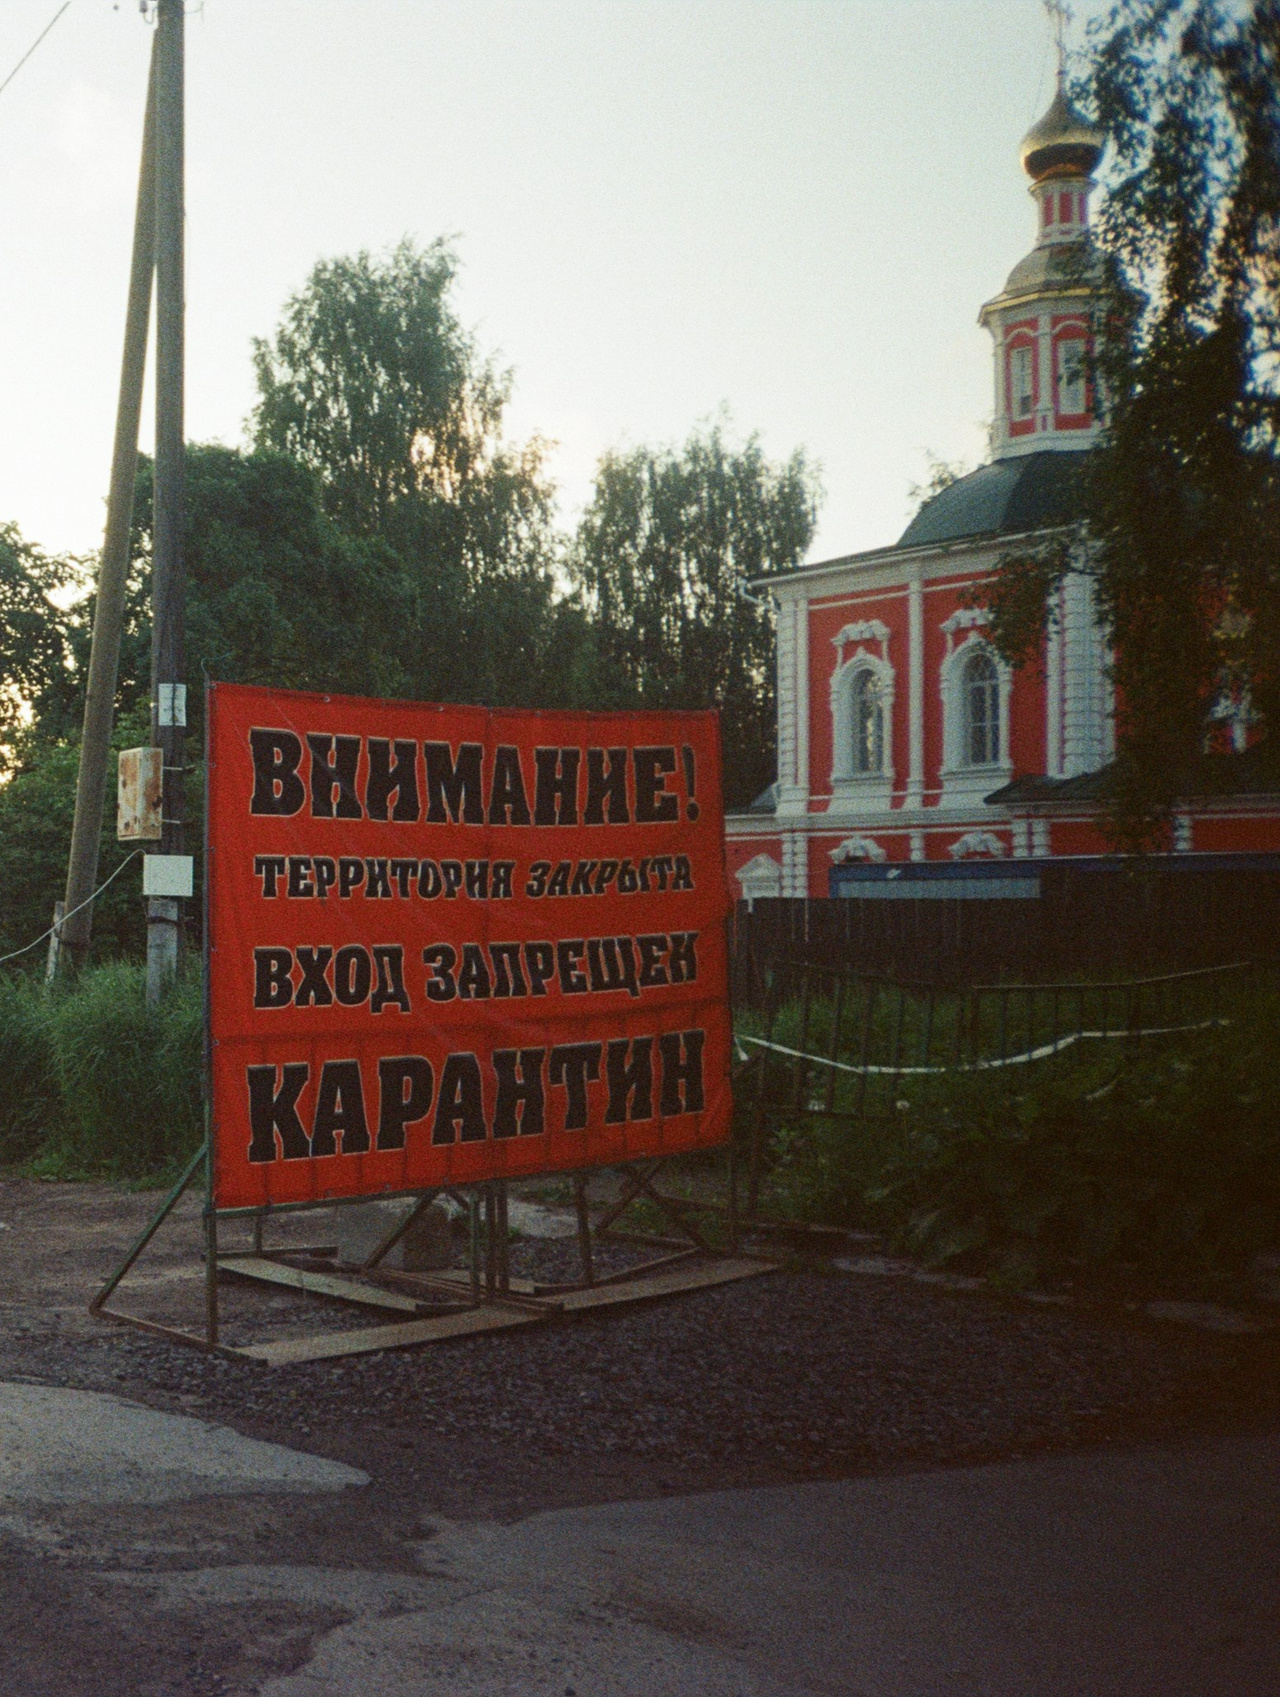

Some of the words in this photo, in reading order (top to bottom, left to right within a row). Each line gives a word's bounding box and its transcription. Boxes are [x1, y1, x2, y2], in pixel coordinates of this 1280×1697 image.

[249, 728, 700, 827] ВНИМАНИЕ!
[254, 854, 515, 899] ТЕРРИТОРИЯ
[526, 855, 695, 897] ЗАКРЫТА
[253, 943, 411, 1014] ВХОД
[423, 931, 699, 1003] ЗАПРЕЩЕН
[247, 1029, 706, 1163] КАРАНТИН
